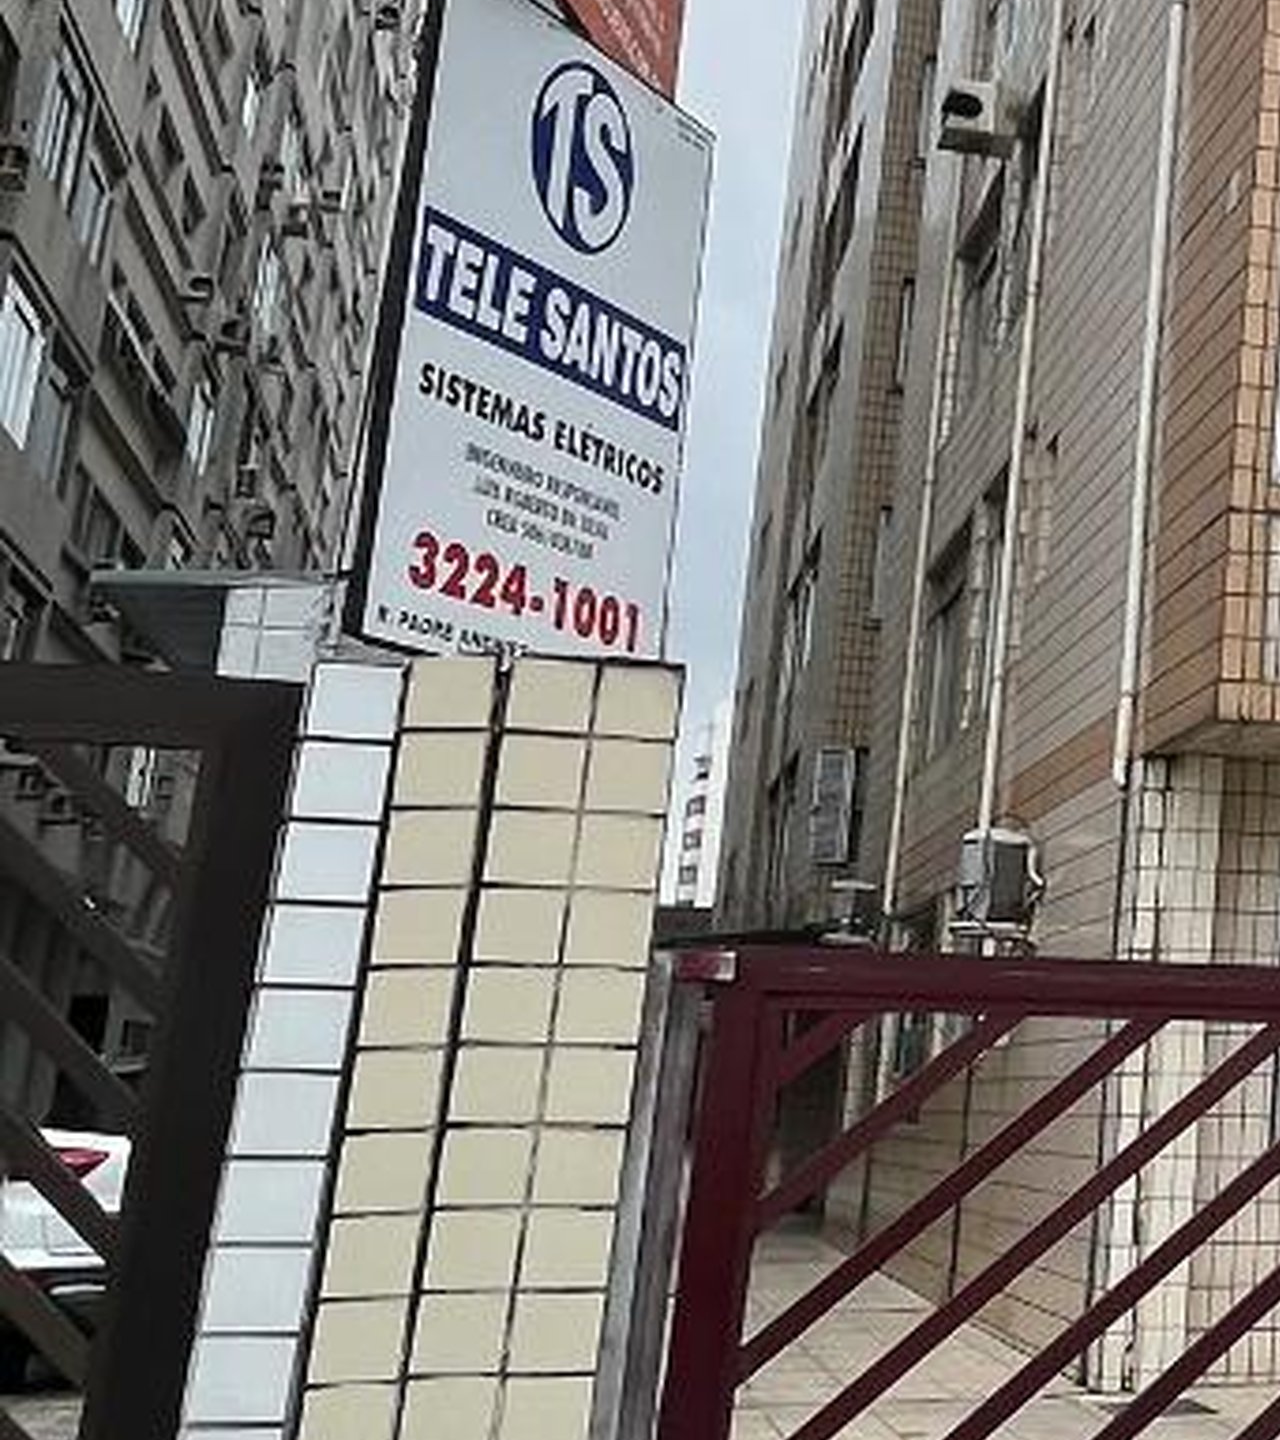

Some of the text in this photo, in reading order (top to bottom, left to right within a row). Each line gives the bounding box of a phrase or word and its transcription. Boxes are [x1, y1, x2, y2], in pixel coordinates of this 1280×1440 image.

[425, 222, 683, 417] TELE SANTOS
[419, 363, 665, 495] SISTEMAS ELÉTRICOS
[408, 531, 639, 653] 3224-1001
